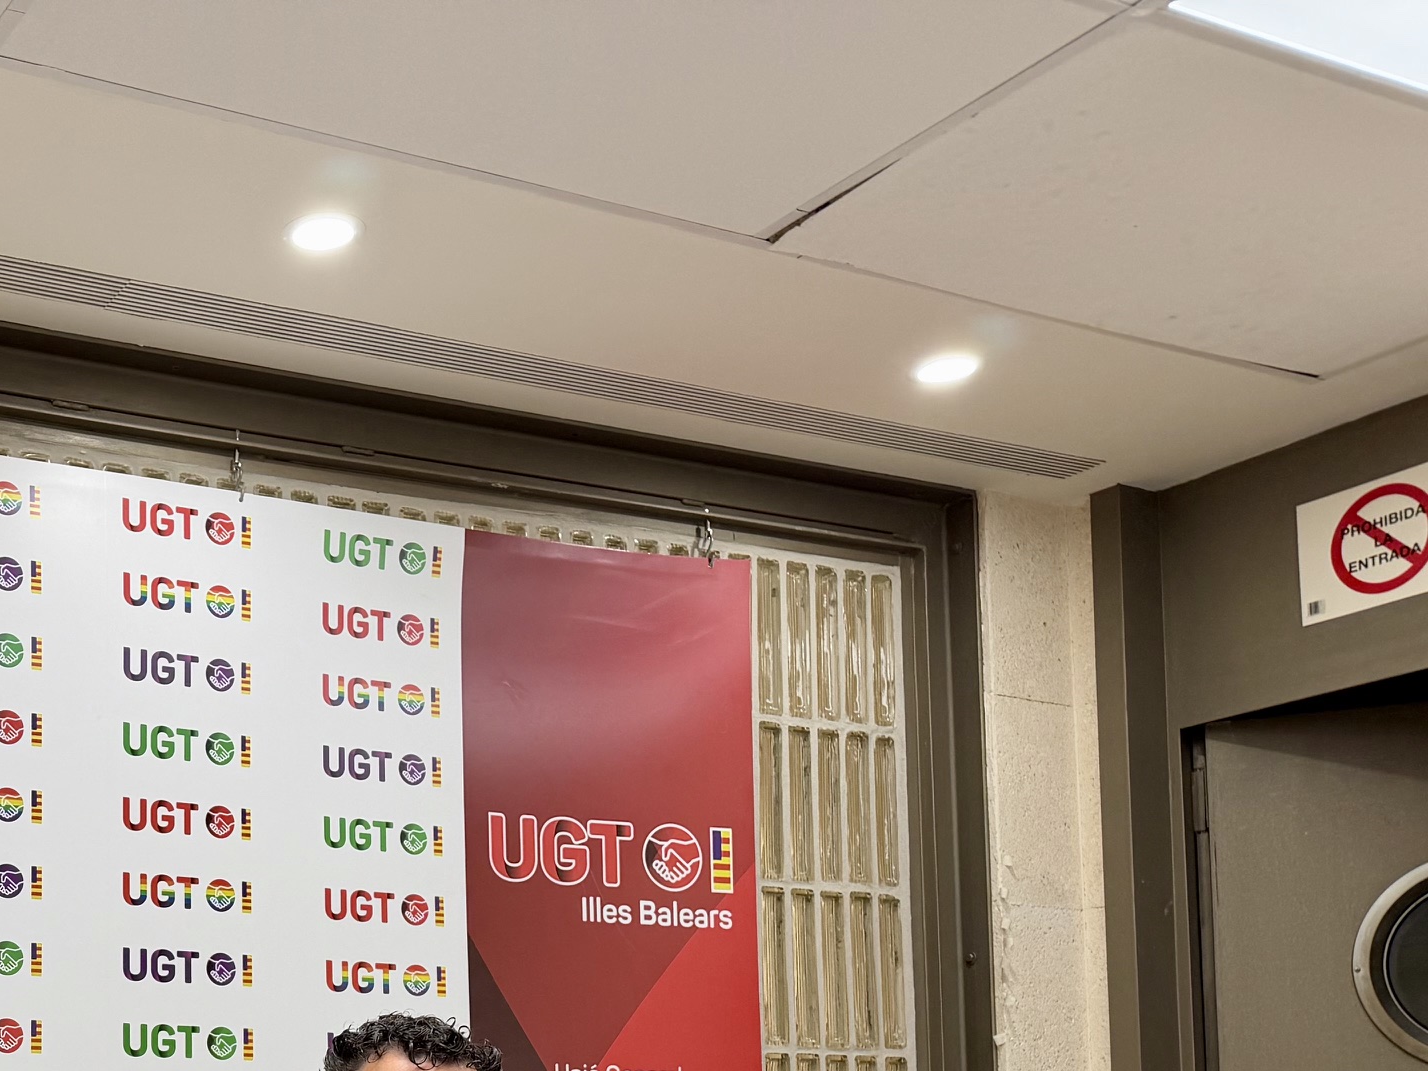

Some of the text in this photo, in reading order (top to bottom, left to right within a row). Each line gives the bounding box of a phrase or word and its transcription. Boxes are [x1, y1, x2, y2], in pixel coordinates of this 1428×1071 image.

[122, 497, 198, 540] UGT
[1340, 503, 1427, 540] PROHIBIDA
[324, 529, 394, 570] UGT
[1348, 542, 1422, 574] ENTRADA
[1374, 532, 1394, 548] LA
[123, 572, 199, 613] UGT
[322, 602, 391, 641] UGT
[123, 647, 199, 687] UGT
[322, 673, 391, 712] UGT
[123, 722, 199, 762] UGT
[323, 745, 392, 782] UGT
[123, 797, 199, 835] UGT
[324, 816, 393, 852] UGT
[487, 811, 634, 888] UGT
[123, 872, 199, 909] UGT
[325, 888, 395, 923] UGT
[581, 897, 733, 930] Illes Balears
[123, 947, 200, 984] UGT
[326, 960, 396, 994] UGT
[123, 1023, 200, 1059] UGT
